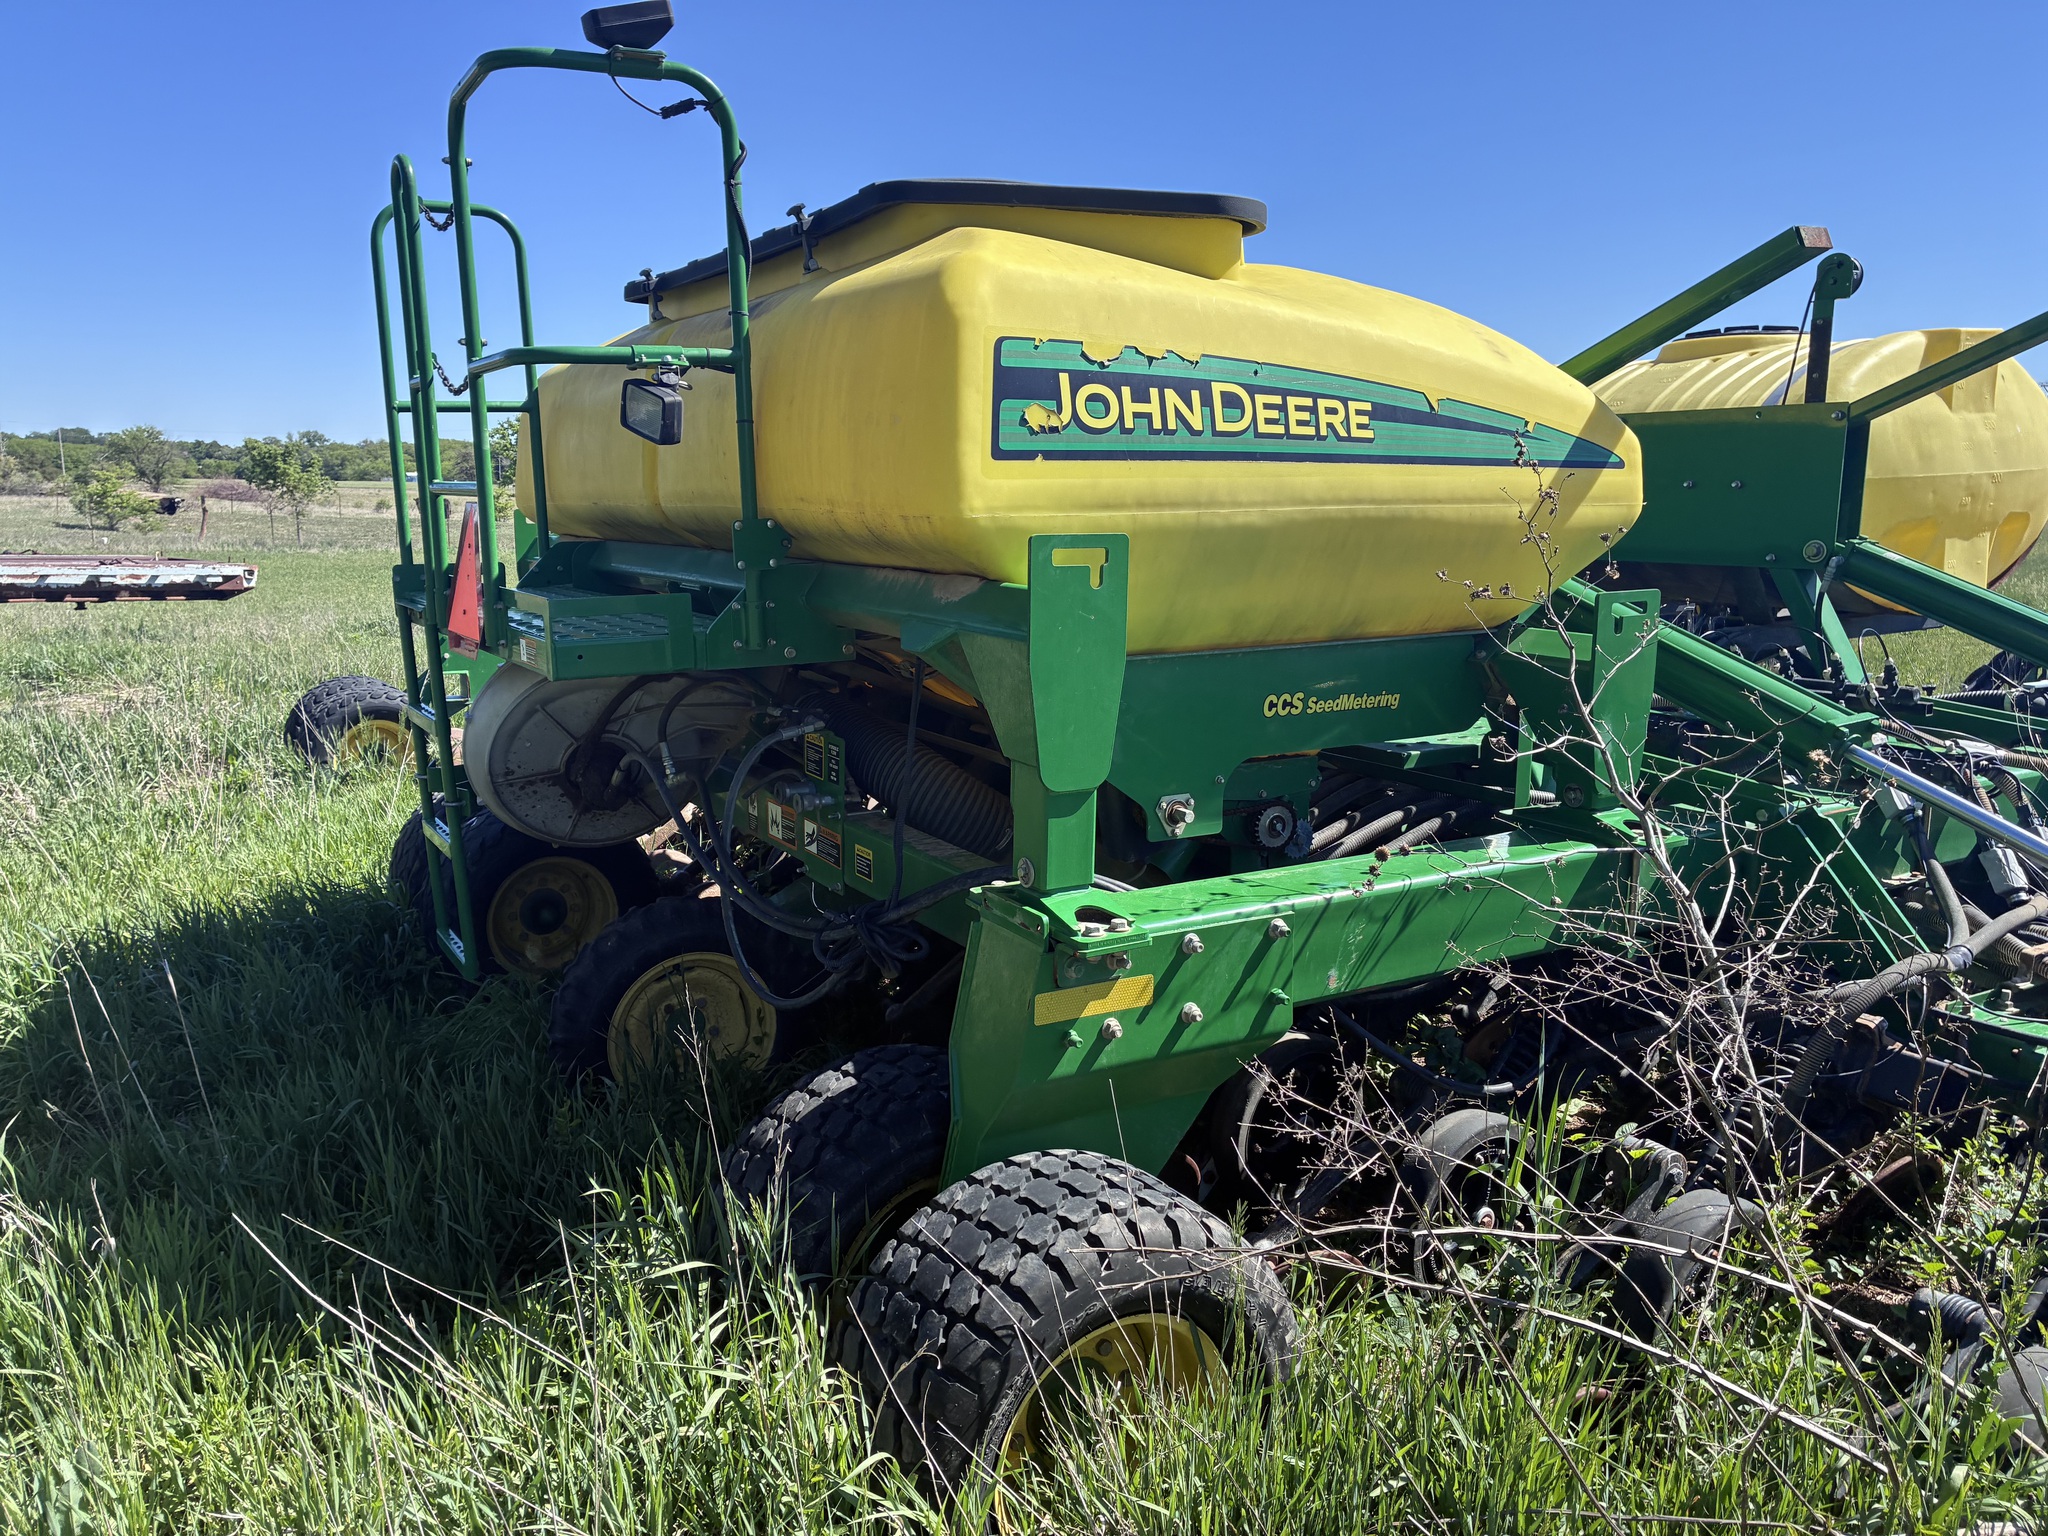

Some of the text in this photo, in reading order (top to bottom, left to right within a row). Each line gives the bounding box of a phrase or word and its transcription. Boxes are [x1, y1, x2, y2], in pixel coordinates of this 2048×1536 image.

[1058, 372, 1375, 440] JOHN DEERE
[1263, 691, 1400, 718] CCS SeedMetering
